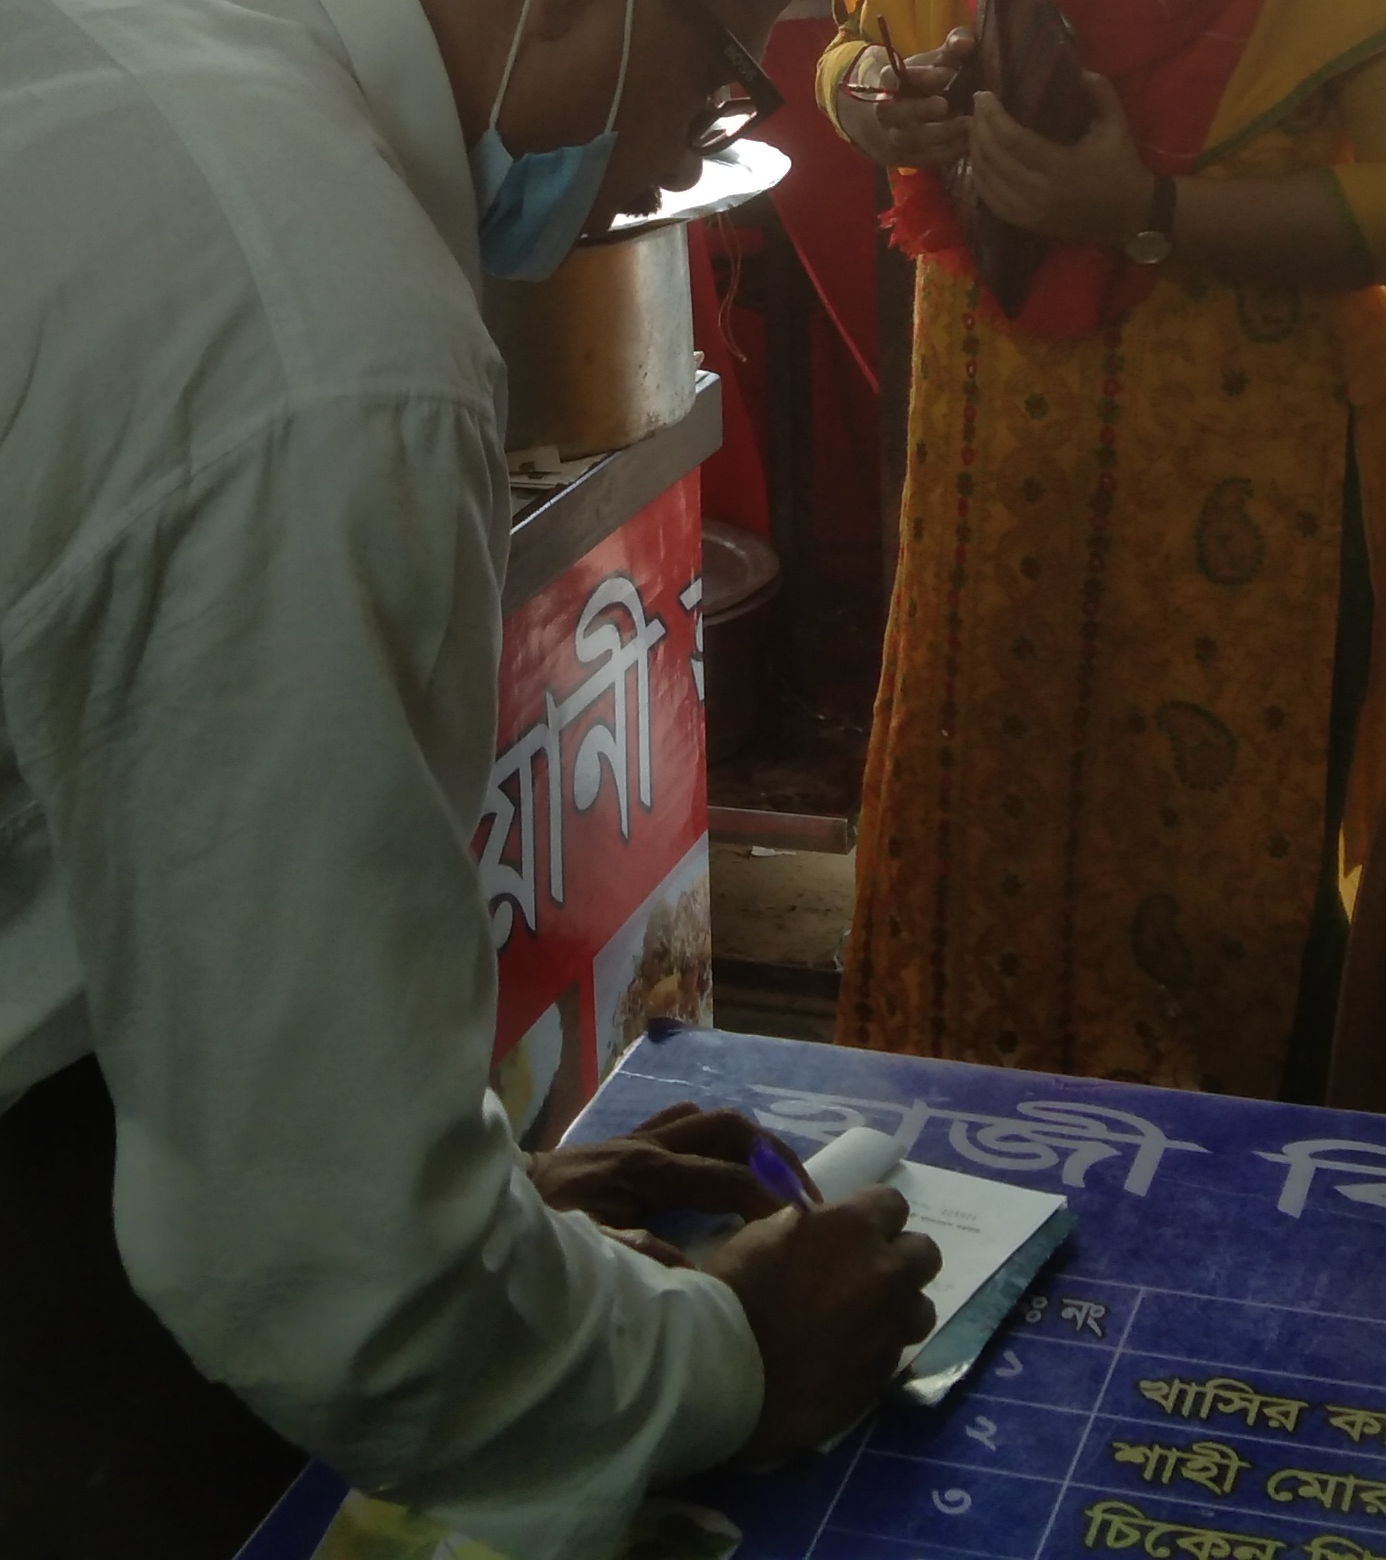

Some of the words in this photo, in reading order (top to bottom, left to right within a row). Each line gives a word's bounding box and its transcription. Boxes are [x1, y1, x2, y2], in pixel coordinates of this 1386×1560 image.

[1061, 1298, 1105, 1337] নং
[995, 1350, 1024, 1378] ১
[1139, 1377, 1309, 1433] খাসির
[965, 1415, 997, 1452] ২
[1112, 1441, 1252, 1495] শাহী
[931, 1487, 972, 1515] ৩
